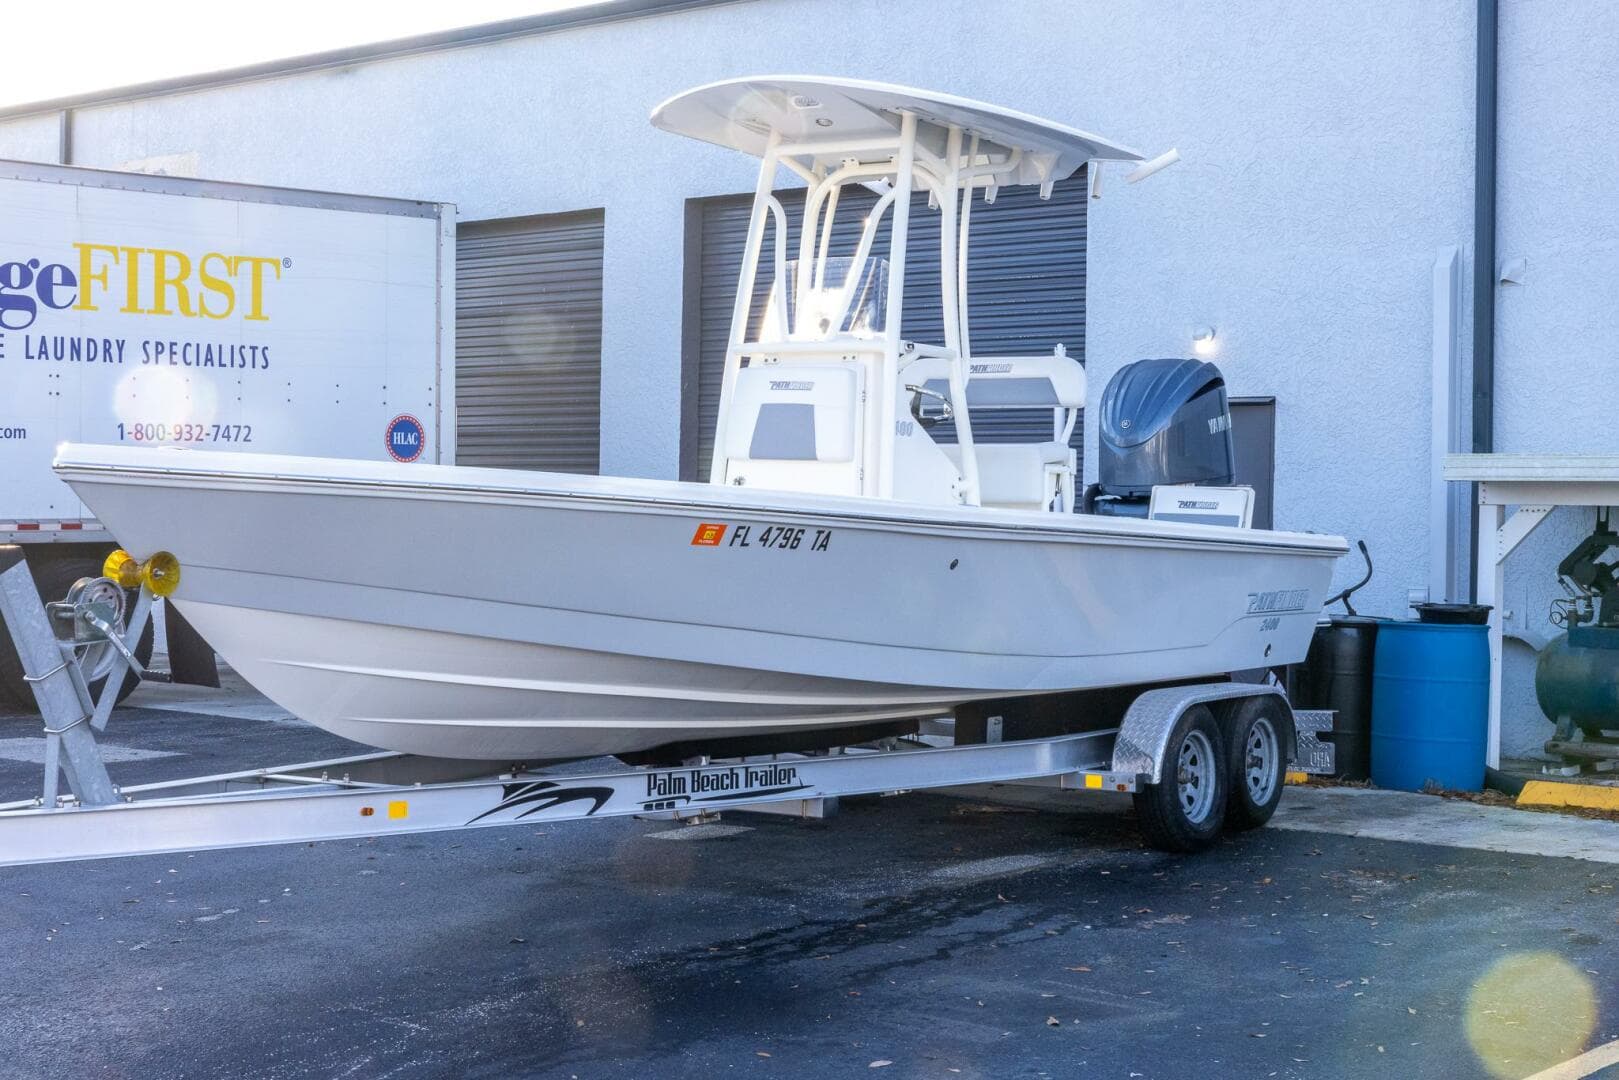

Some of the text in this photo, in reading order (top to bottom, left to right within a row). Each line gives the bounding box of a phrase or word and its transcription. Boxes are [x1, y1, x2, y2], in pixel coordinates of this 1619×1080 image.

[25, 335, 126, 363] LAUNDRY
[142, 340, 270, 370] SPECIALISTS
[117, 422, 252, 442] 1-800-932-7472
[393, 431, 418, 445] HLAC
[729, 525, 751, 547] FL
[758, 526, 806, 550] 4796
[811, 529, 833, 551] TA
[647, 764, 797, 797] Palm Beach Trailer
